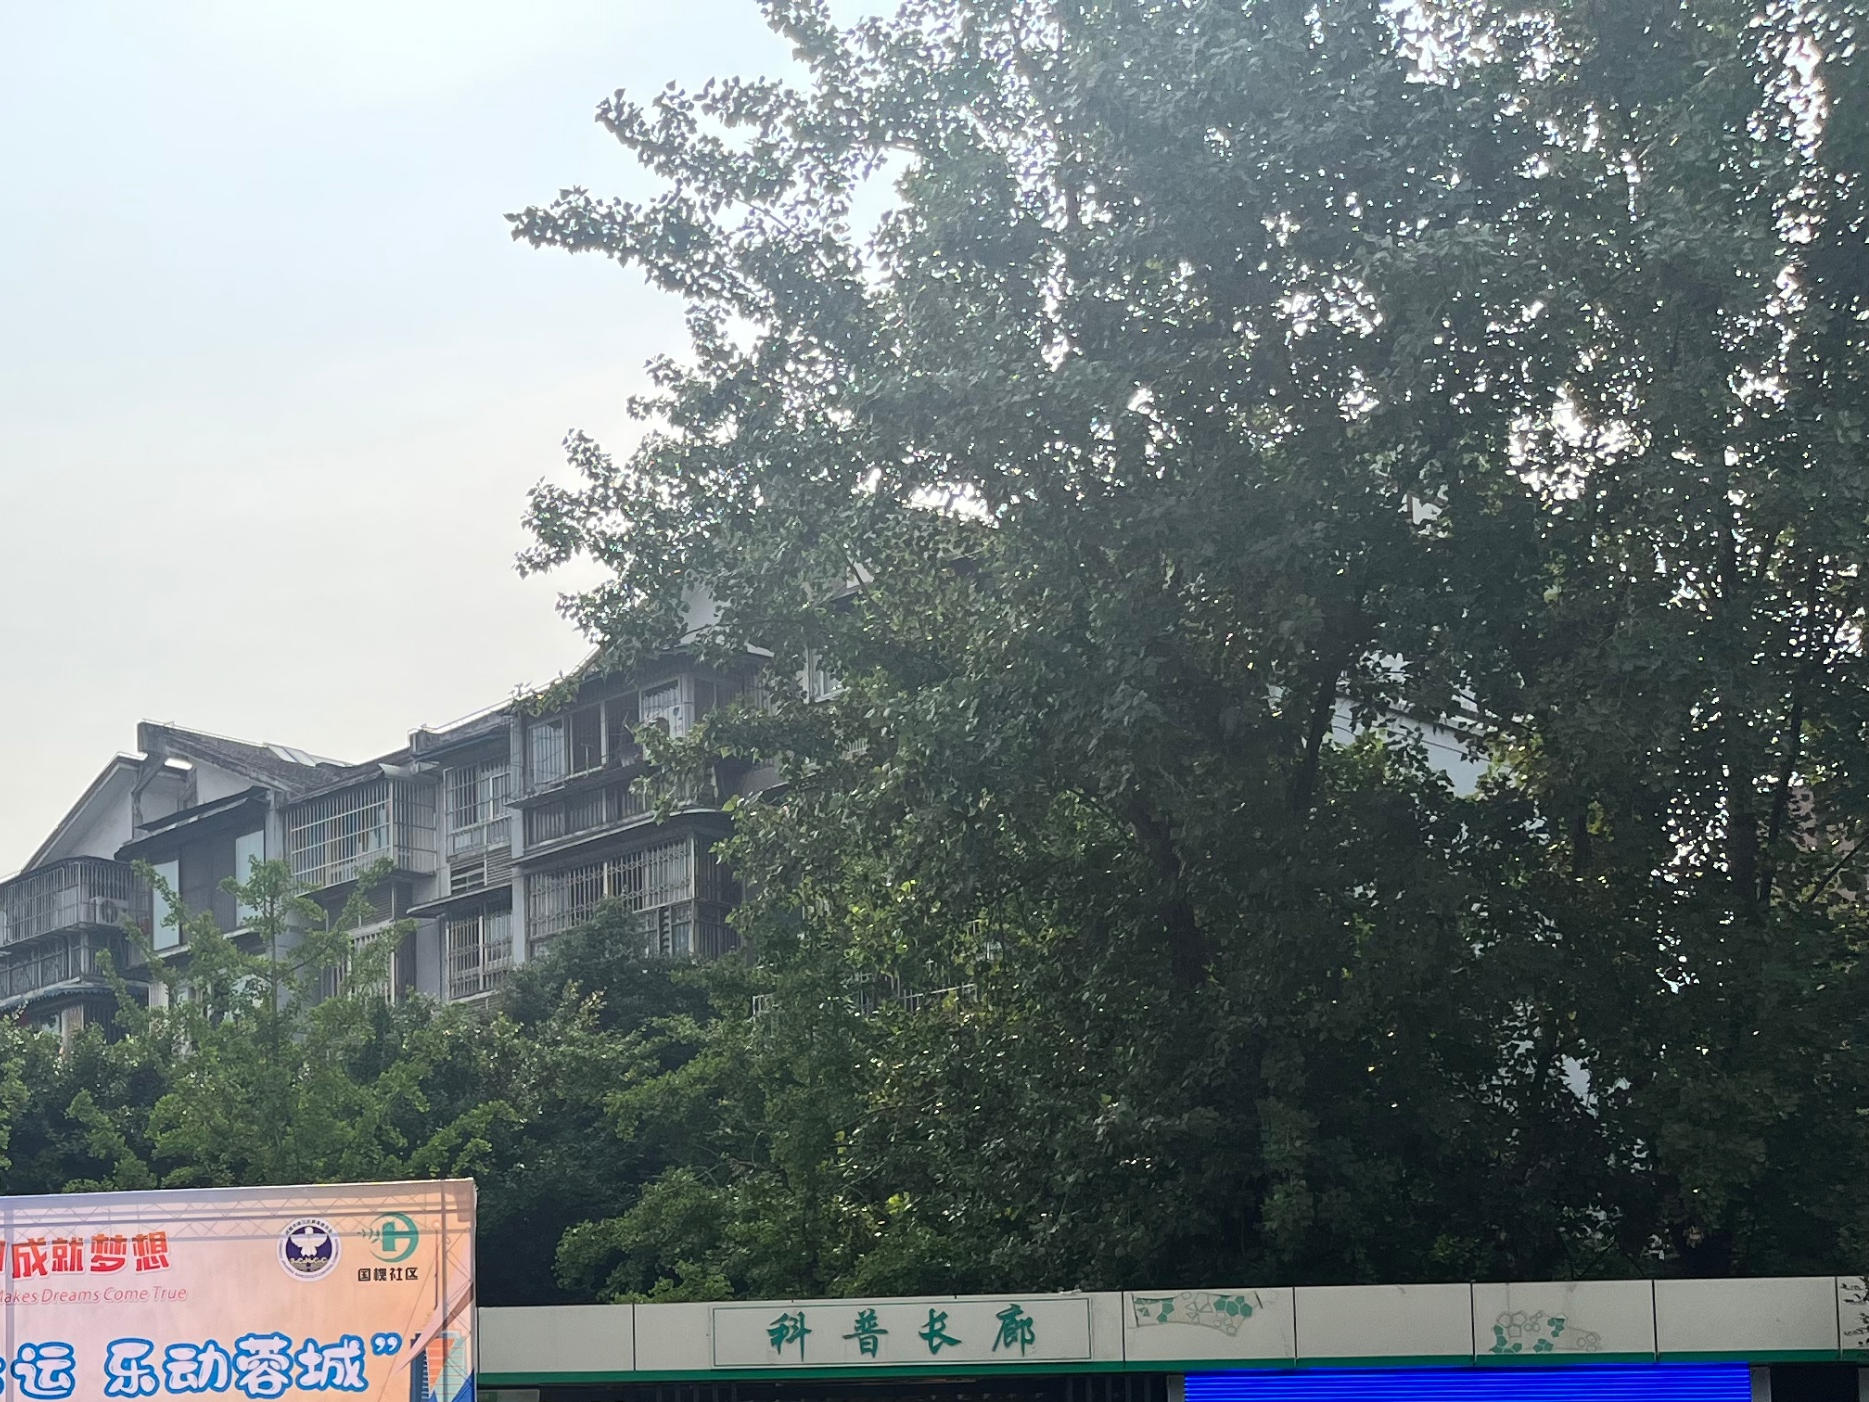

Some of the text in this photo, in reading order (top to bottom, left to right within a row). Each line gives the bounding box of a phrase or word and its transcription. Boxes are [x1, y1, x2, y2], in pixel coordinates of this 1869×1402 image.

[358, 1267, 419, 1282] 国槐社区
[41, 1287, 100, 1303] Dreams
[103, 1286, 148, 1302] Come
[152, 1285, 187, 1300] True
[767, 1303, 1035, 1362] 科普长廊
